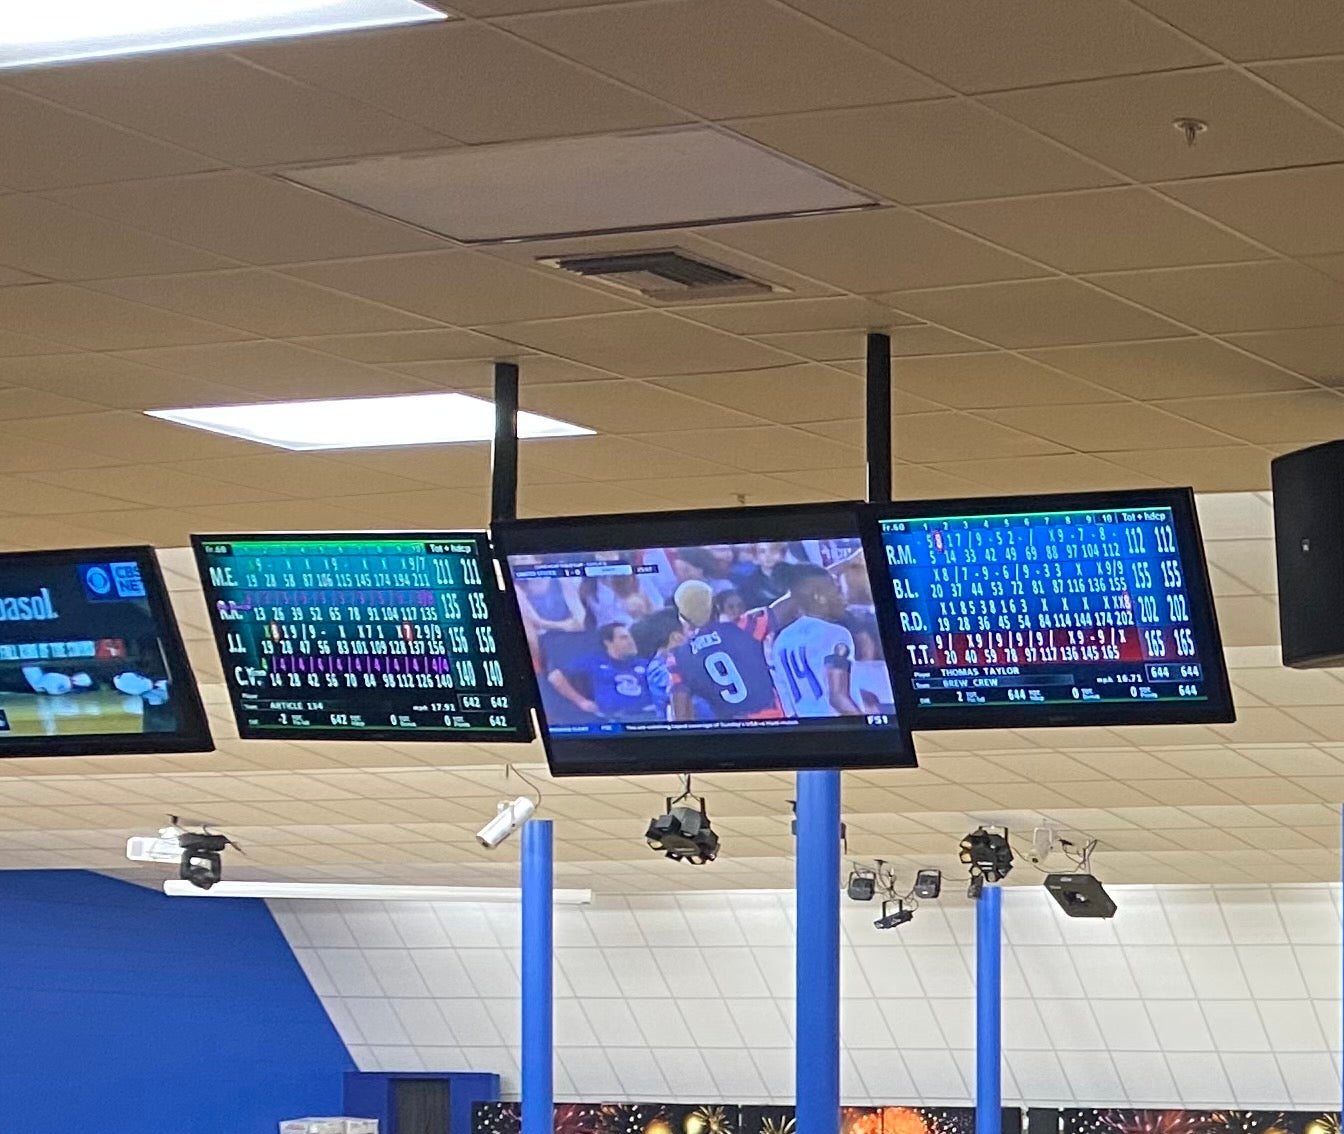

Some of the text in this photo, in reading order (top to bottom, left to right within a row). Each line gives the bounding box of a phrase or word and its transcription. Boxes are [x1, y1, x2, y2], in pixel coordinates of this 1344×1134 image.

[886, 525, 1176, 565] R.M. 112 112
[209, 558, 482, 587] M.E. 211 211
[893, 560, 1182, 599] B.L. 155 155
[441, 592, 462, 620] 135
[468, 592, 489, 620] 135
[900, 594, 1189, 632] R.D. 202 202
[448, 626, 468, 653] 156
[476, 626, 496, 654] 156
[906, 628, 1196, 665] T.T. 20 40 59 78 97 117 136 145 165 165 165
[456, 660, 476, 687] 140
[482, 660, 504, 687] 140
[704, 651, 748, 704] 9
[781, 646, 824, 701] 14
[940, 667, 1020, 677] THOMAS TAYLOR
[942, 679, 968, 688] BREW
[972, 678, 998, 687] CREW
[1150, 666, 1200, 678] 644 644
[462, 696, 509, 708] 642 642
[1178, 684, 1198, 696] 644
[270, 702, 304, 710] ARTICLE
[866, 714, 889, 726] FS1
